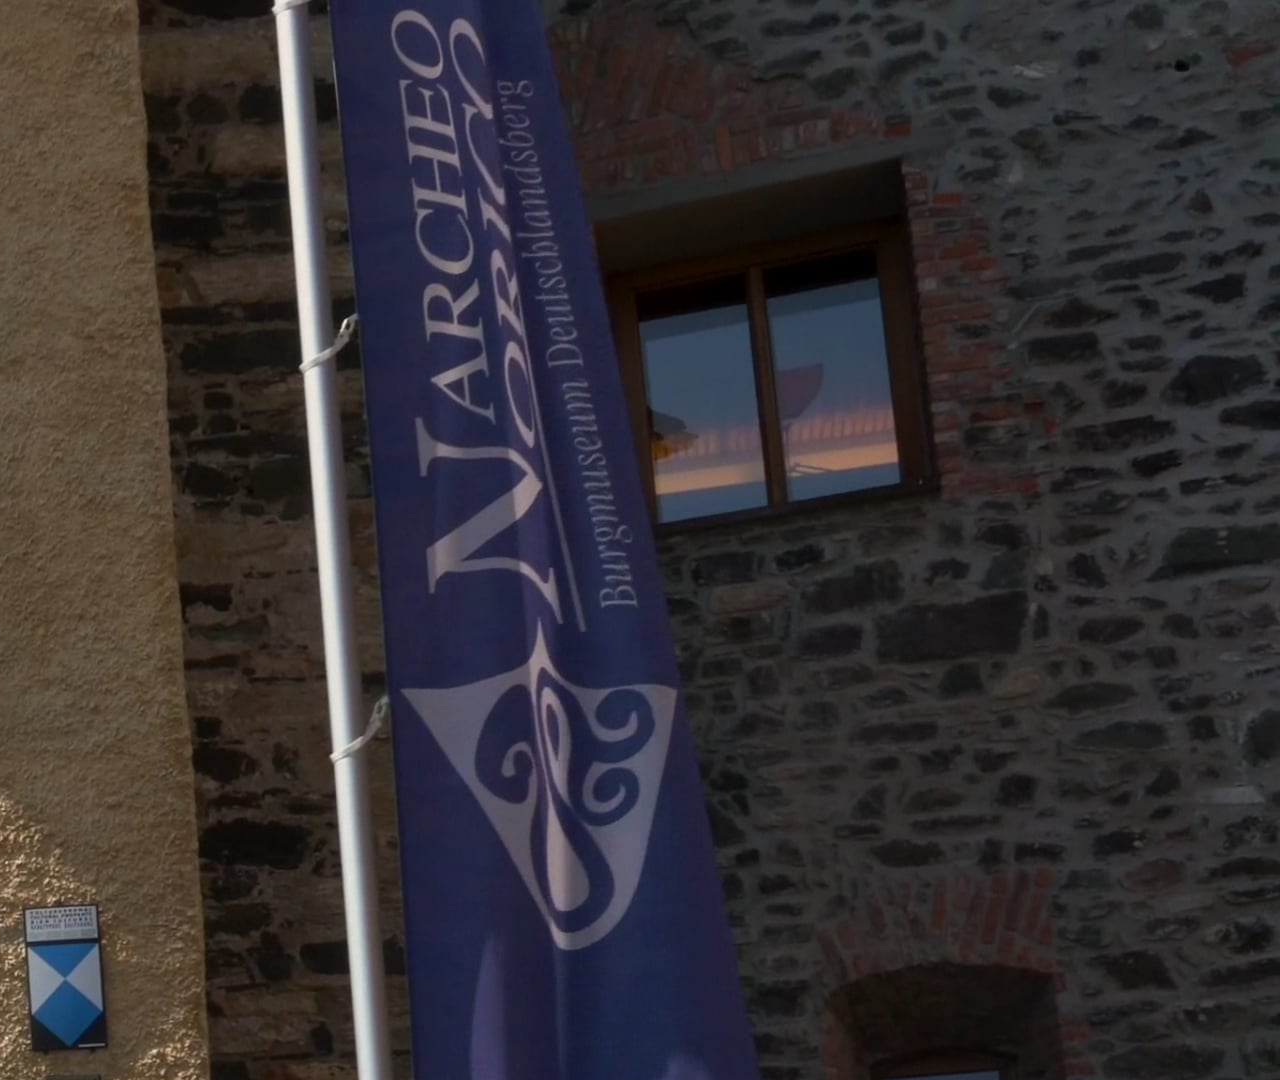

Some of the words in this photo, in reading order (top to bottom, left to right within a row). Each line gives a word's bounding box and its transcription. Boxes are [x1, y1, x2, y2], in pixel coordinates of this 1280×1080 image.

[390, 8, 496, 427] ARCHEO
[496, 78, 586, 368] Deutschlandsberg
[564, 379, 639, 609] Burgmuseum
